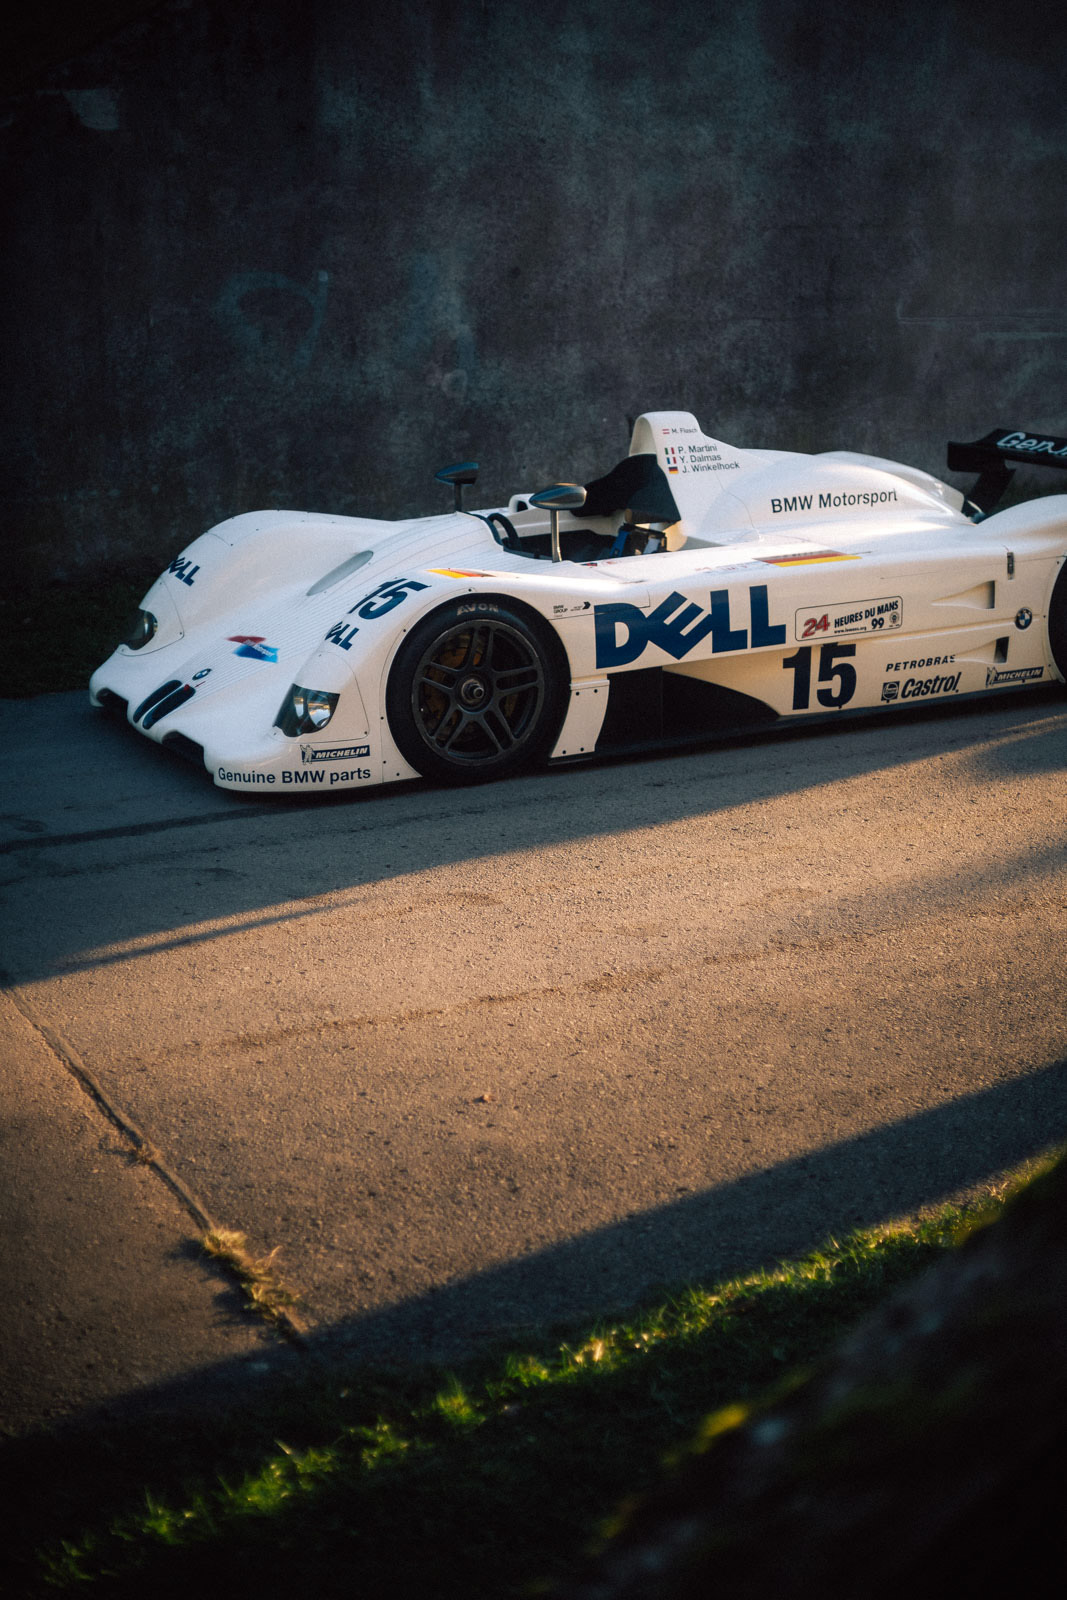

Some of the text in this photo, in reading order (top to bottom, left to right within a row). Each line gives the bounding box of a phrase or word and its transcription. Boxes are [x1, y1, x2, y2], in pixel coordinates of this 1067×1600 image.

[678, 444, 717, 454] P. Martini
[996, 431, 1067, 456] Genu
[679, 454, 722, 464] Y. Dalmas
[682, 461, 740, 474] J. Winkelhock
[771, 488, 898, 513] BMW Motorsport
[168, 556, 201, 587] ELL
[347, 578, 432, 620] 15
[457, 603, 499, 616] AVON
[594, 585, 787, 669] DELL
[802, 600, 899, 639] 24 HEURES DU MANS
[871, 617, 885, 630] 99
[324, 620, 360, 651] ELL
[886, 654, 956, 672] PETROBRAS
[783, 642, 857, 710] 15
[901, 671, 962, 699] Castrol
[998, 668, 1042, 681] MICHELIN
[315, 747, 369, 759] MICHELIN
[218, 767, 371, 785] Genuine BMW parts
